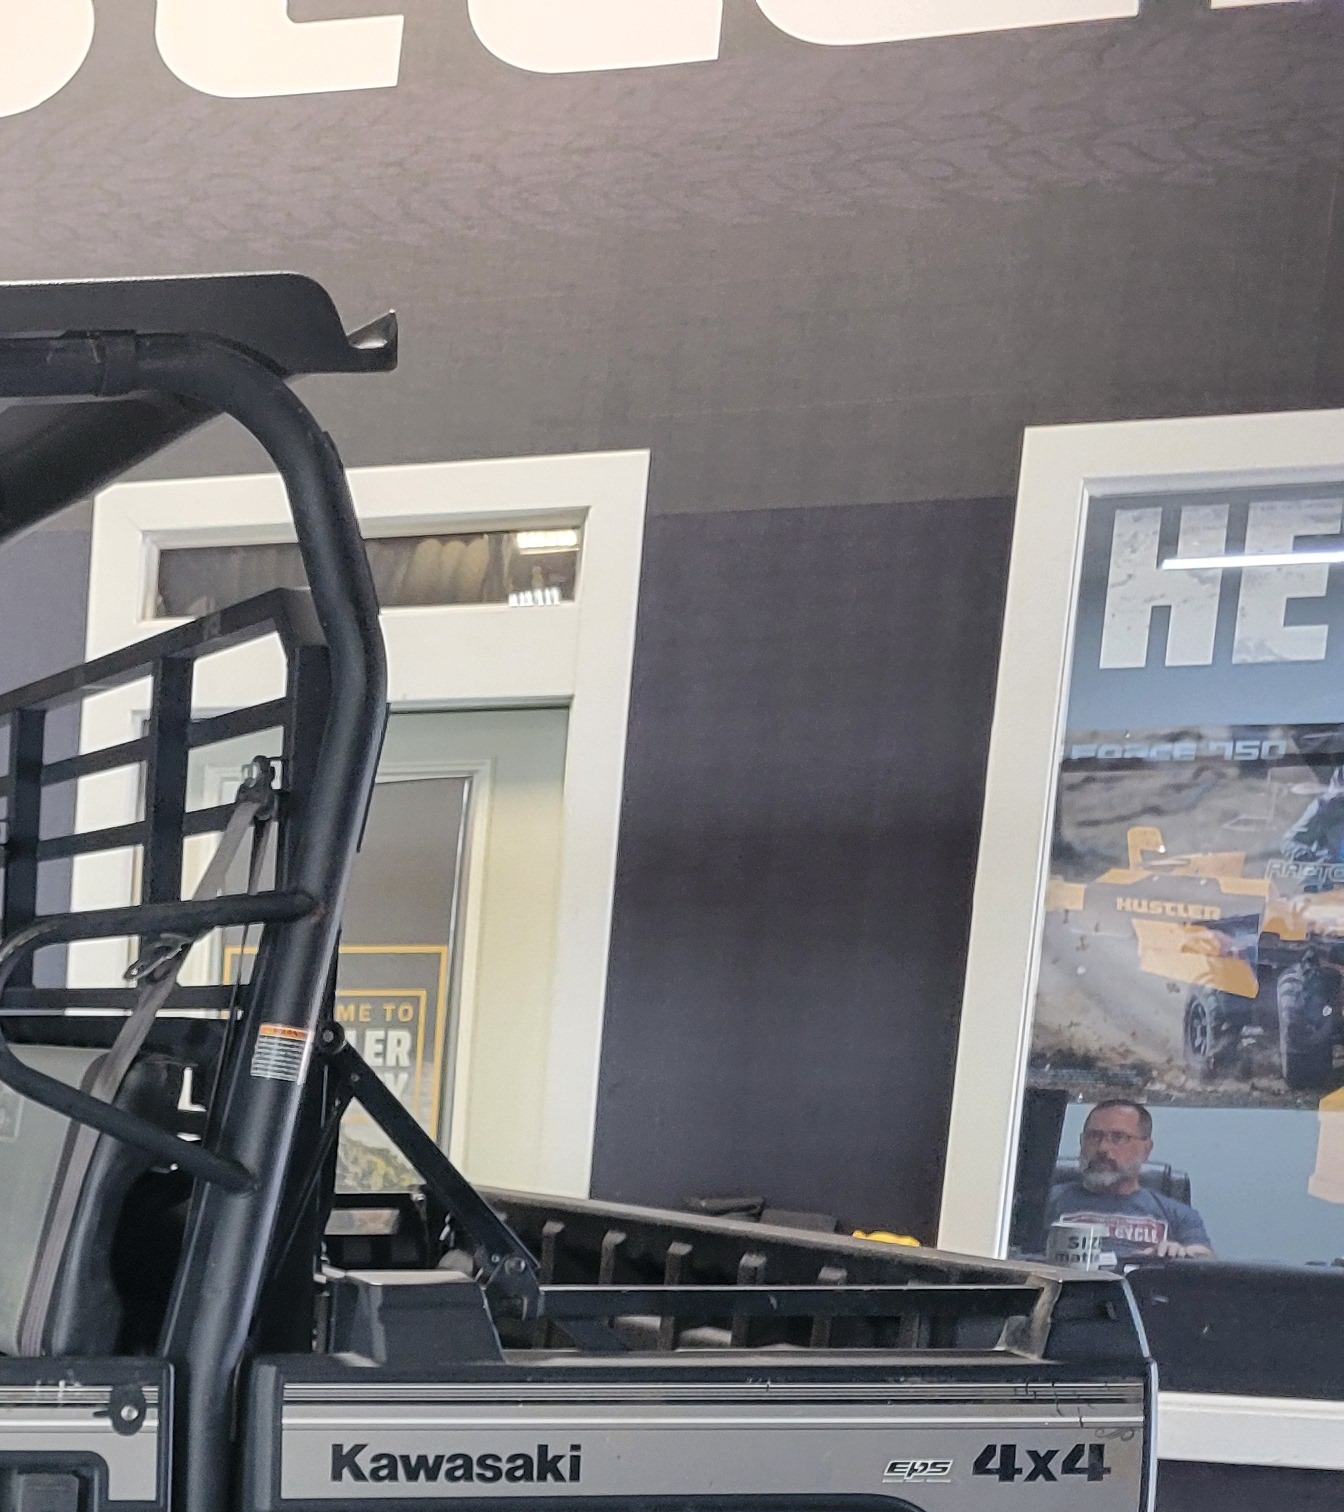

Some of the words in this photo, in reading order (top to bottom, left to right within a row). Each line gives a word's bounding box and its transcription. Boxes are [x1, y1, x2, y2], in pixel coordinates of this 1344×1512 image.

[1115, 896, 1221, 921] HUSTLER
[383, 1002, 414, 1022] TO
[330, 1443, 583, 1484] Kawasaki
[972, 1443, 1112, 1482] 4x4
